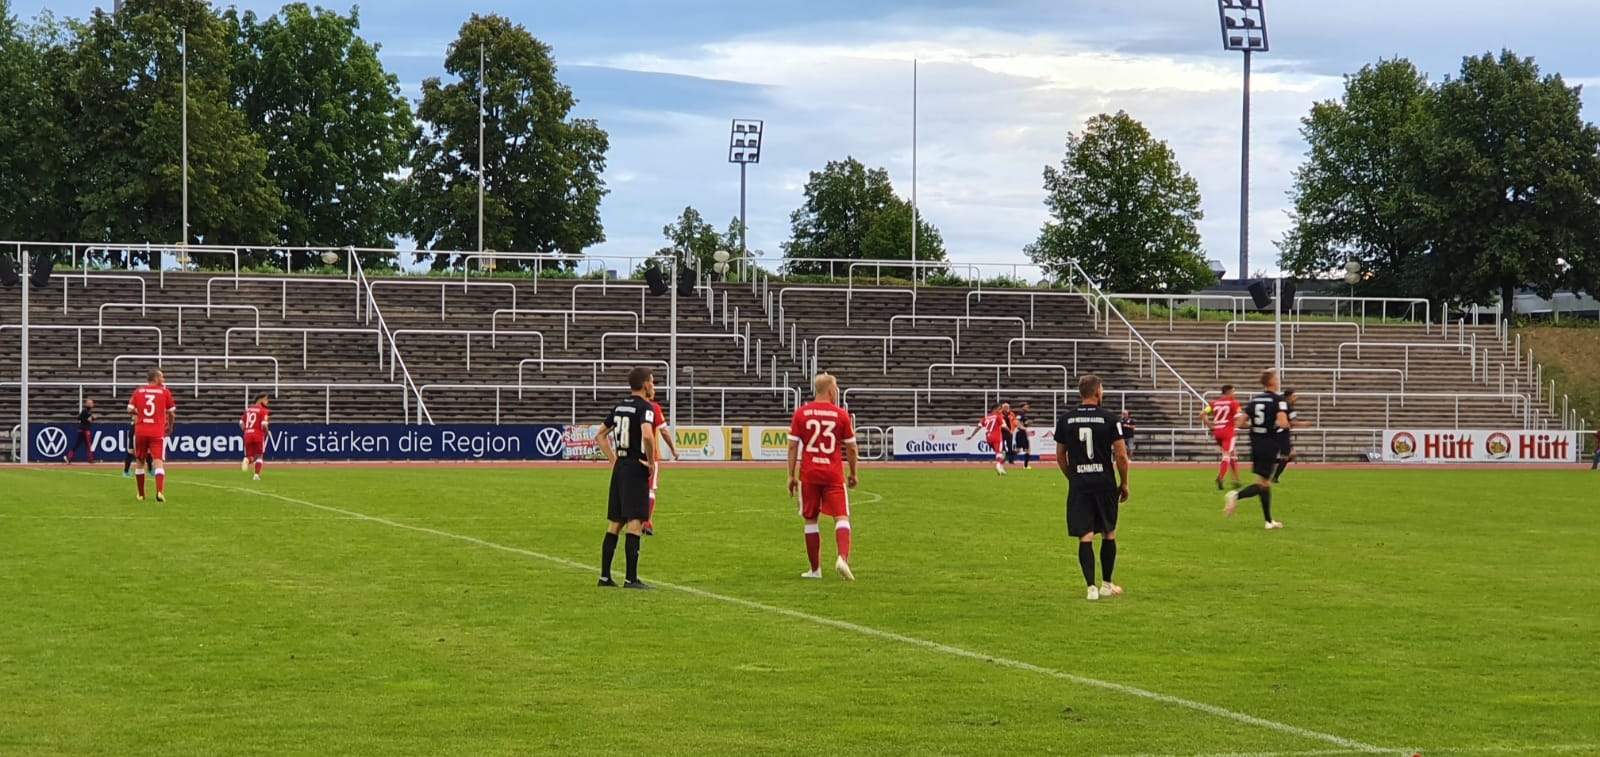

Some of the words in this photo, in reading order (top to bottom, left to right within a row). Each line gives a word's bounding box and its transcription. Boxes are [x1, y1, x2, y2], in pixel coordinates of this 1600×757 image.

[143, 395, 156, 417] 3
[1213, 406, 1230, 425] 22
[1254, 404, 1266, 425] 5
[245, 412, 257, 429] 19
[613, 415, 630, 449] 28
[90, 430, 244, 458] Volwagen
[264, 431, 299, 452] Wir
[306, 431, 390, 452] stärken
[398, 431, 433, 452] die
[442, 431, 520, 458] Region
[675, 431, 708, 446] AMP
[805, 419, 837, 454] 23
[905, 440, 958, 452] Caldener
[1079, 427, 1095, 460] 7
[1424, 434, 1475, 459] Hütt
[1519, 434, 1570, 459] Hütt
